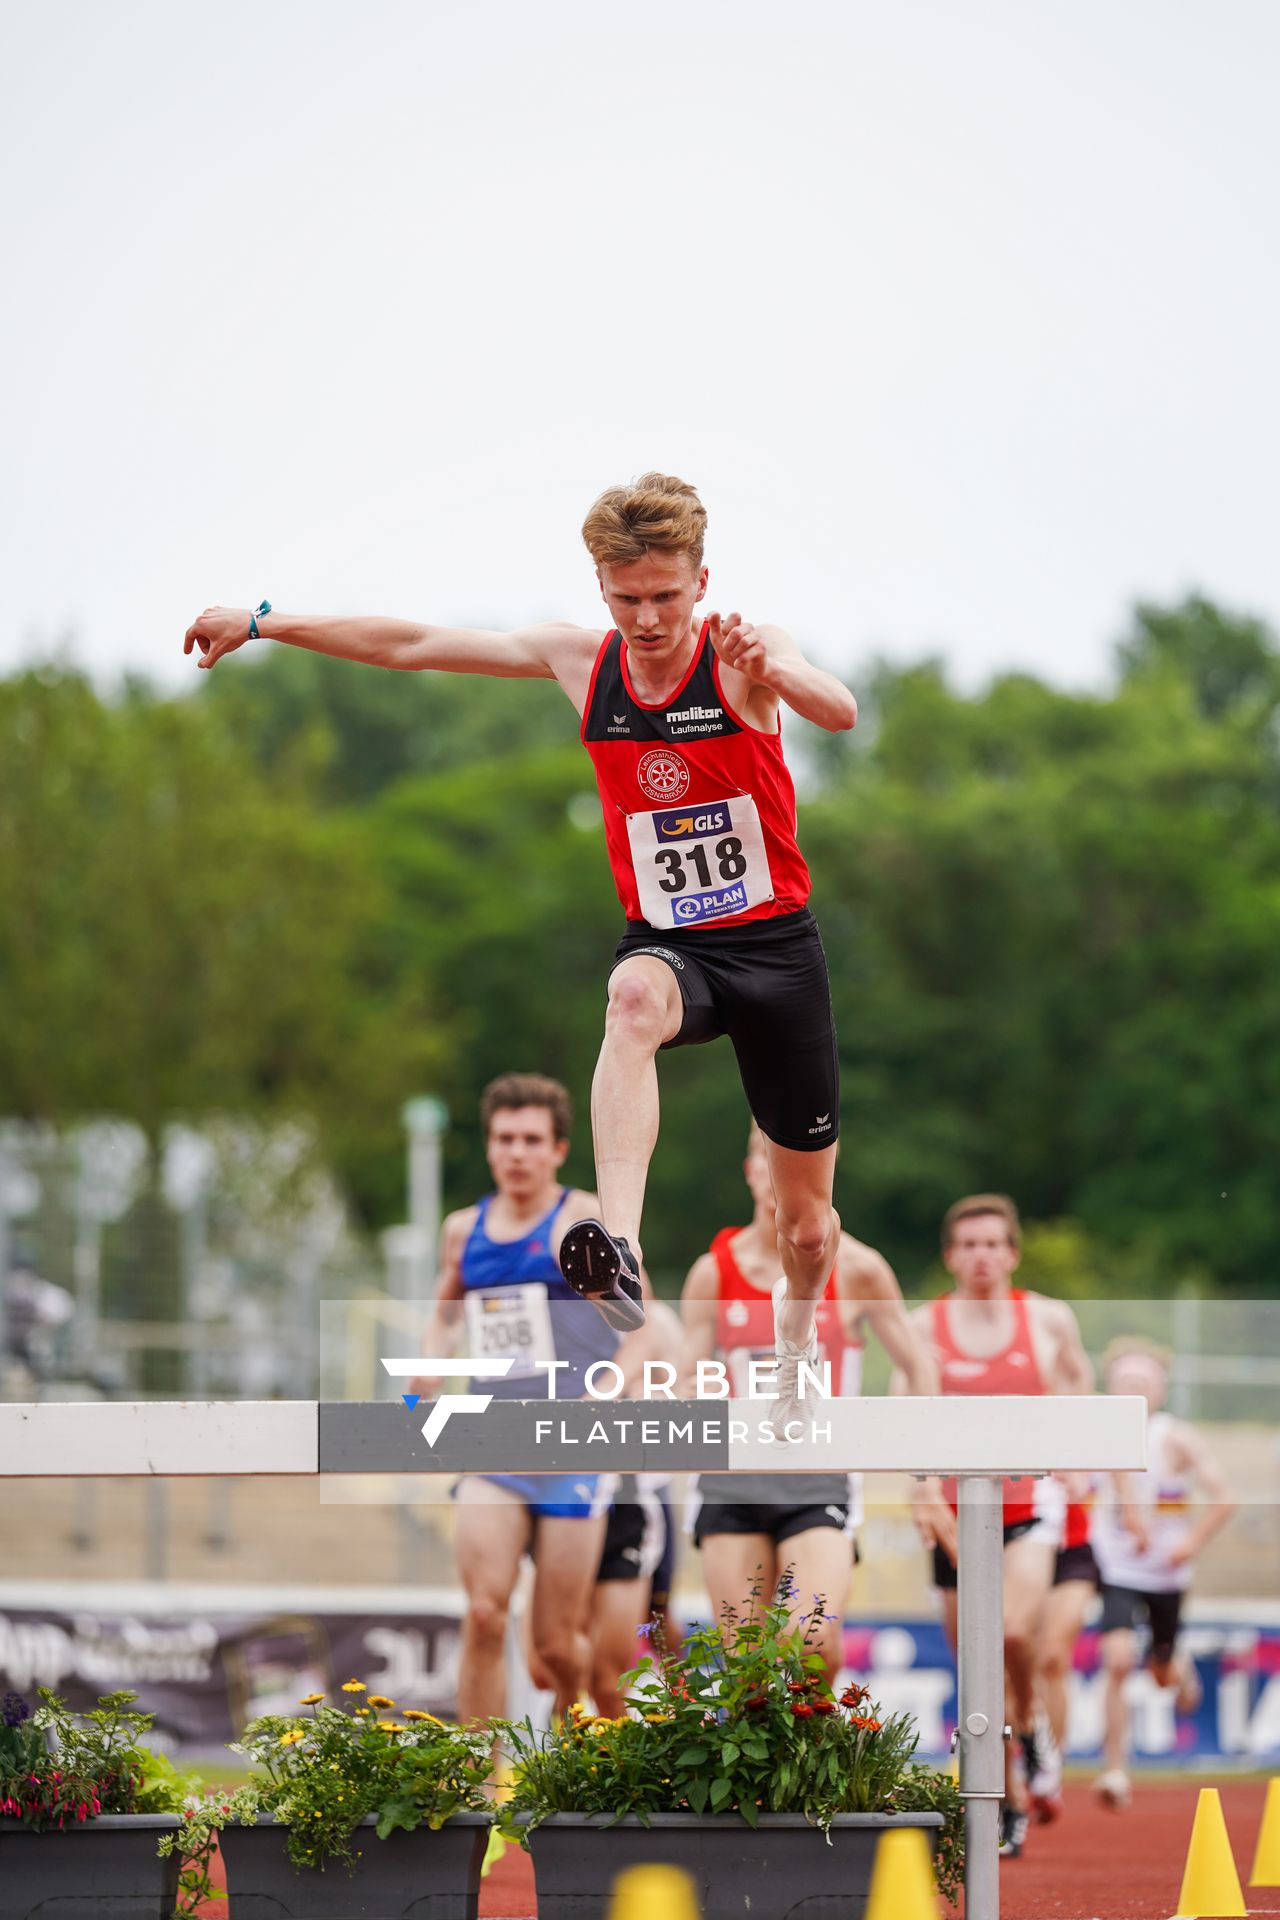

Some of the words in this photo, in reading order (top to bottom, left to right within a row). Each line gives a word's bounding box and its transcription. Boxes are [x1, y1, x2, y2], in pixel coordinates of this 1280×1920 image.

[607, 726, 631, 734] erima
[671, 723, 723, 735] Laufanalyse
[694, 812, 724, 832] GLS
[655, 836, 747, 893] 318
[702, 887, 744, 909] PLAN
[808, 1122, 832, 1134] erima
